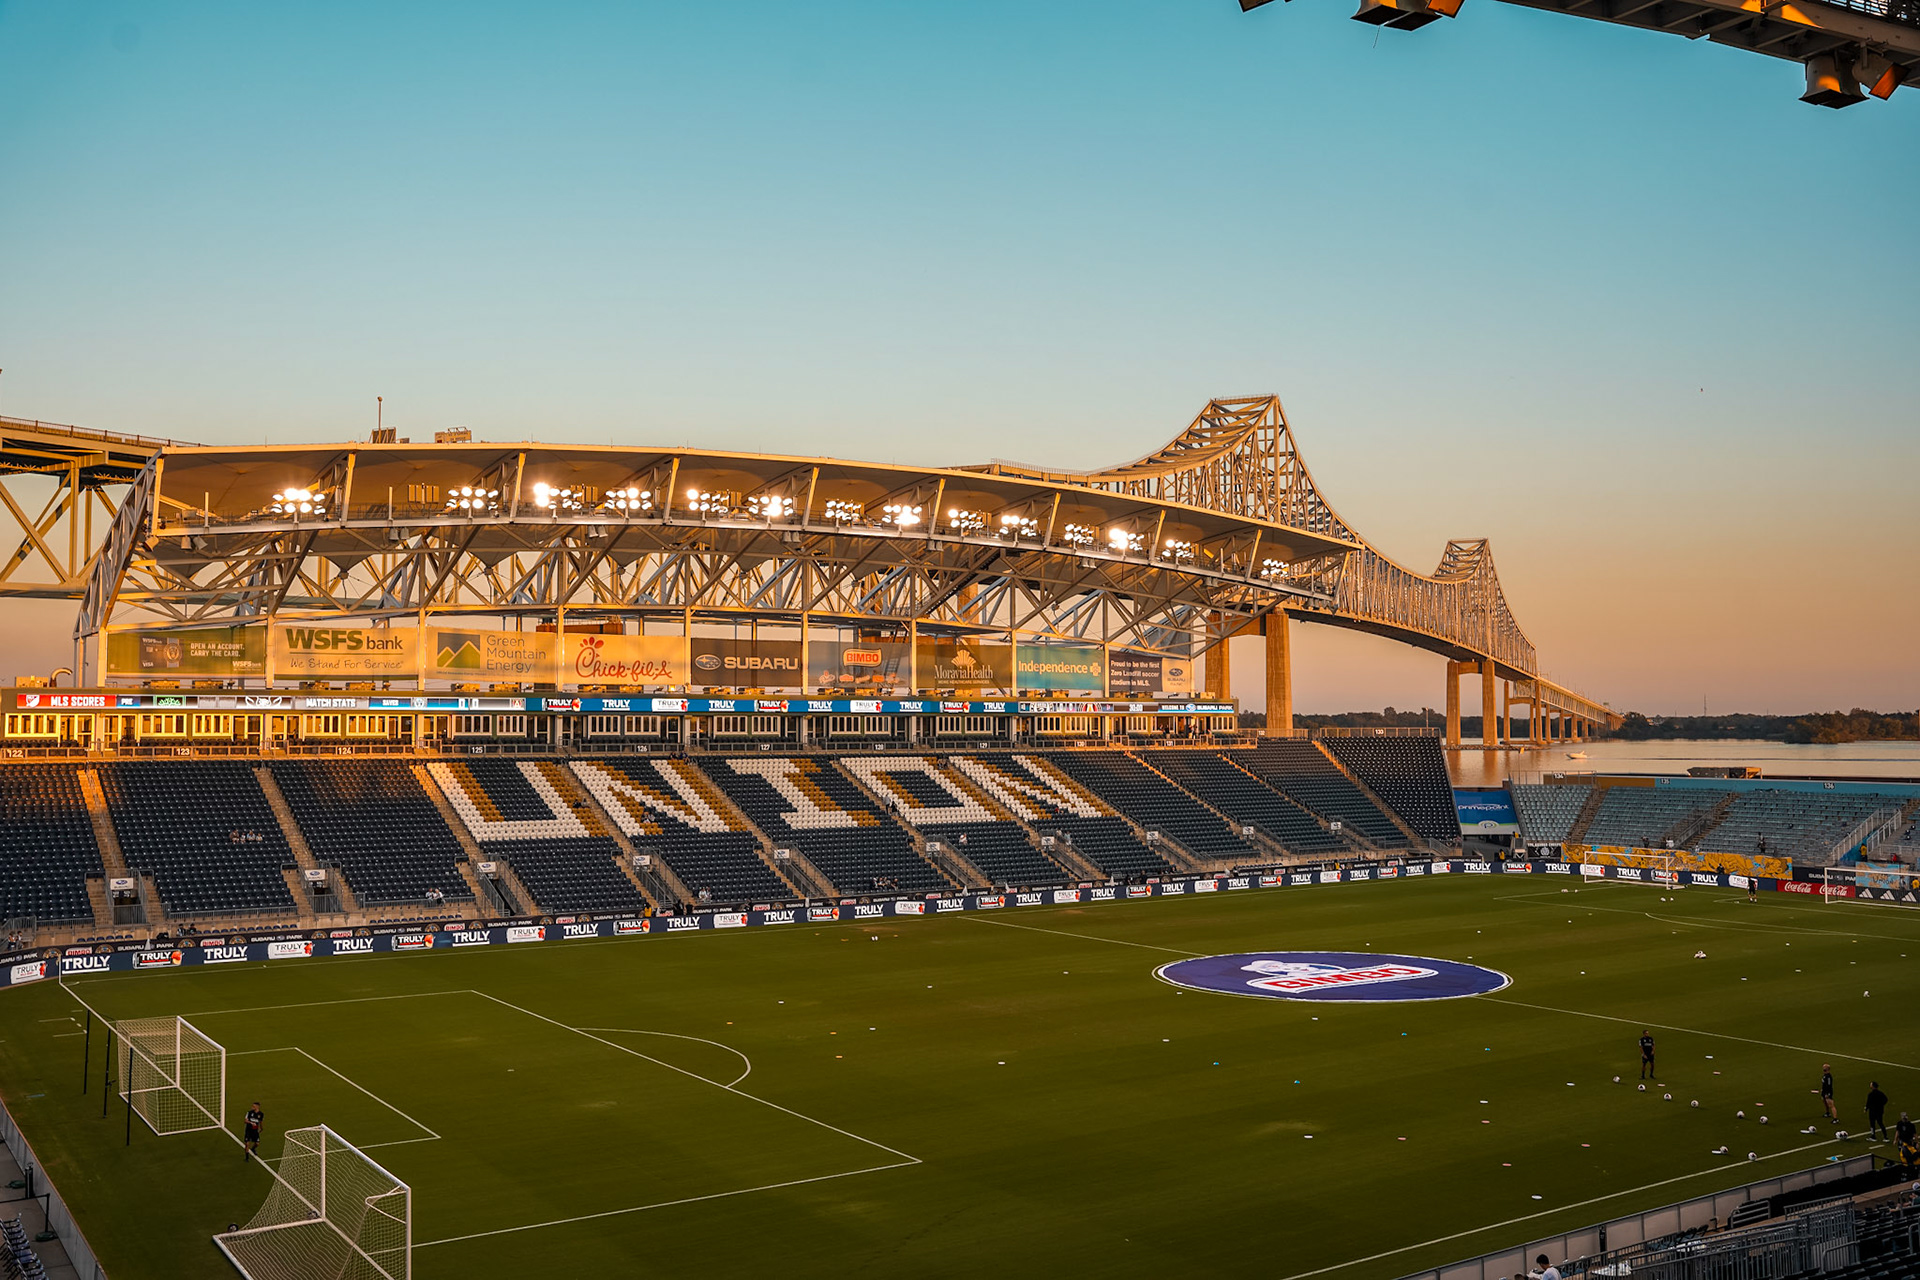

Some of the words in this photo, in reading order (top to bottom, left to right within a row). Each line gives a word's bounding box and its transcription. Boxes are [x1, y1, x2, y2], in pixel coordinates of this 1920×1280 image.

[285, 628, 364, 651] WSFS
[366, 636, 403, 650] bank
[486, 635, 525, 647] Green
[217, 643, 245, 651] ACCOUNT.
[486, 648, 547, 660] Mountain
[846, 653, 879, 663] BIMBO
[290, 658, 305, 668] We
[308, 657, 341, 669] Stand
[344, 659, 361, 669] For
[364, 659, 402, 669] Service
[486, 659, 532, 673] Energy
[576, 645, 672, 682] Chick-fil-A
[724, 656, 799, 670] SUBARU
[1018, 660, 1088, 675] Independence
[1110, 660, 1126, 668] Proud
[1132, 660, 1139, 668] be
[1149, 661, 1160, 669] first
[50, 696, 69, 707] MLS
[71, 696, 106, 707] SCORES
[305, 698, 332, 708] MATCH
[332, 698, 357, 708] STATS
[602, 699, 630, 708] TRULY
[709, 700, 735, 708] TRULY
[808, 700, 833, 709] TRULY
[899, 702, 923, 710] TRULY
[983, 702, 1006, 710] TRULY
[6, 748, 24, 758] 122
[176, 748, 190, 756] 123
[338, 747, 352, 755] 124
[471, 746, 483, 754] 125
[425, 755, 1108, 843] UNION
[1406, 865, 1425, 874] TRULY
[1464, 862, 1491, 871] TRULY
[1546, 863, 1571, 872] TRULY
[1350, 869, 1370, 878] TRULY
[1617, 867, 1642, 877] TRULY
[1228, 877, 1250, 888] TRULY
[1291, 873, 1312, 883] TRULY
[1691, 873, 1718, 883] TRULY
[1161, 883, 1185, 893] TRULY
[1784, 881, 1813, 894] Coca-Cola
[1016, 893, 1042, 903] TRULY
[1091, 888, 1116, 898] TRULY
[936, 898, 964, 909] TRULY
[855, 904, 884, 915] TRULY
[764, 910, 795, 921] TRULY
[619, 920, 642, 928] TRULY
[667, 917, 700, 929] TRULY
[563, 923, 599, 936] TRULY
[397, 935, 425, 943] TRULY
[452, 930, 490, 943] TRULY
[275, 943, 302, 951] TRULY
[332, 938, 373, 951] TRULY
[23, 952, 38, 960] PARK
[140, 951, 171, 961] TRULY
[203, 946, 248, 960] TRULY
[62, 955, 111, 970] TRULY
[16, 964, 38, 974] TRULY
[1259, 965, 1424, 991] BIMBO
